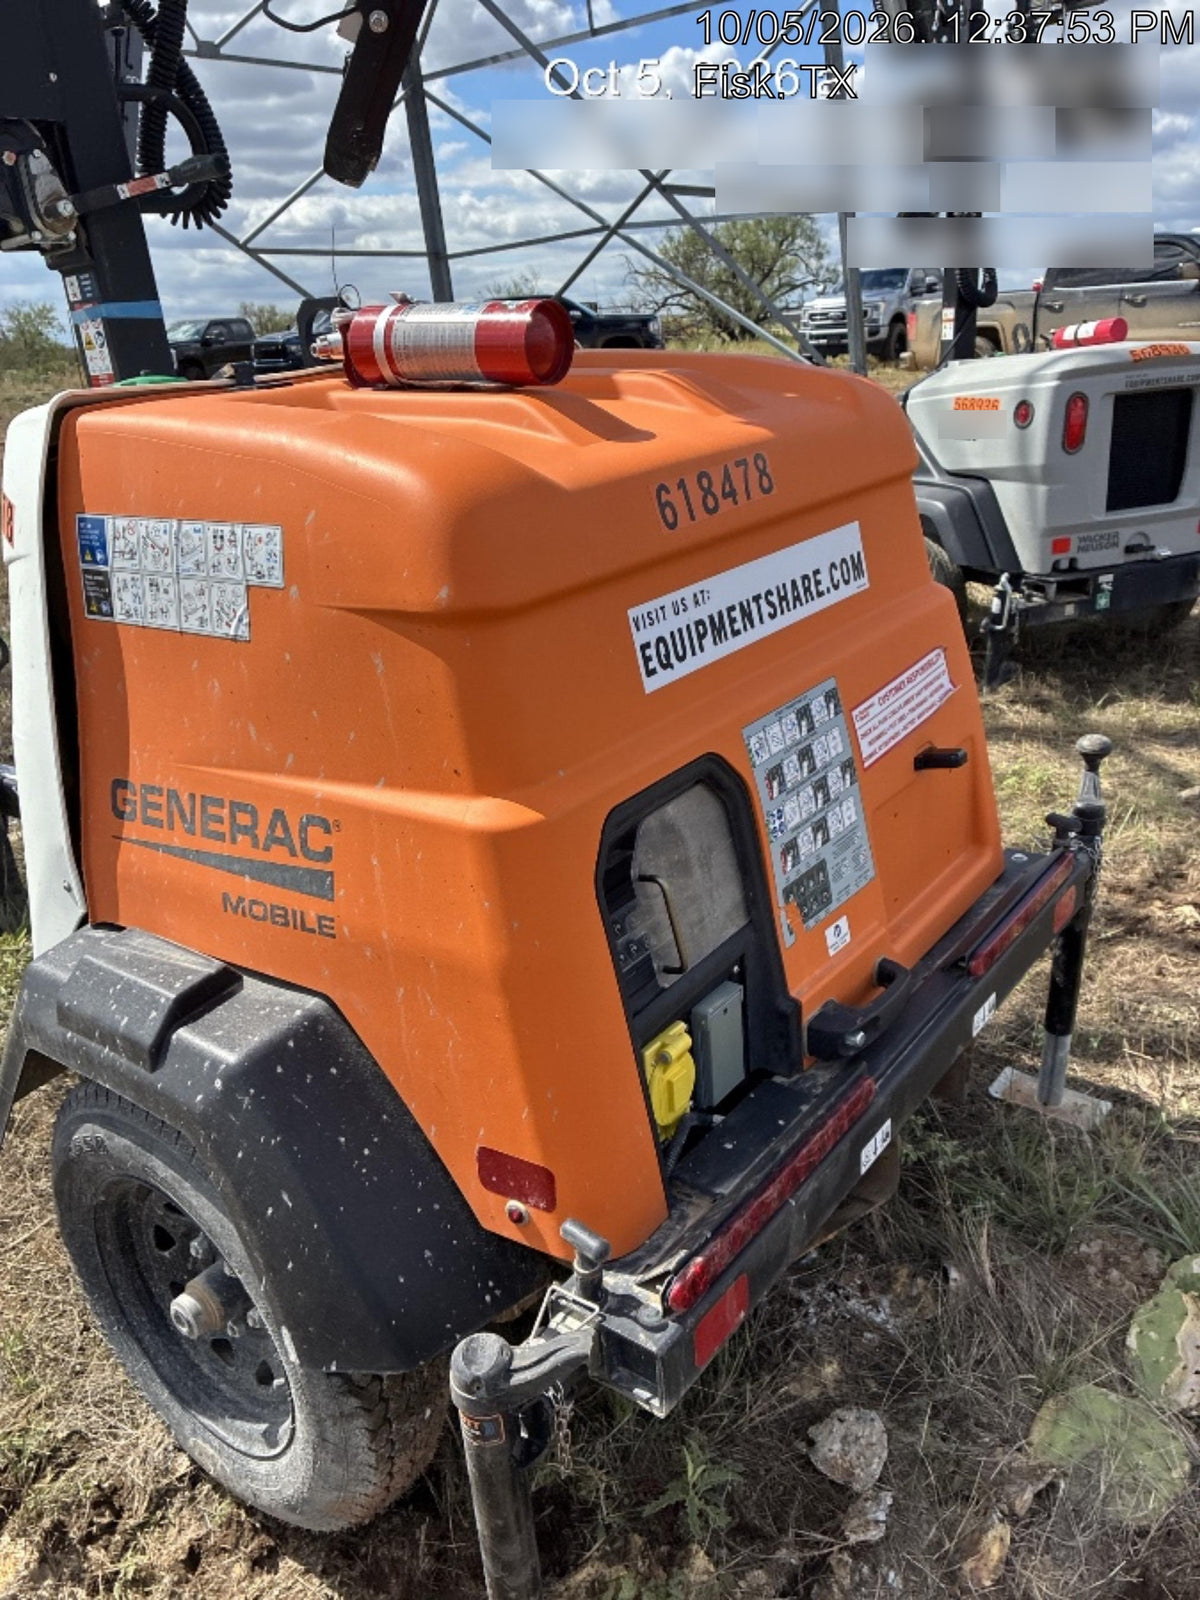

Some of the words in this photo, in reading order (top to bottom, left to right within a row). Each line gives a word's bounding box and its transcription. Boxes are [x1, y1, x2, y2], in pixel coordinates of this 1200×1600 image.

[655, 452, 775, 531] 618478
[632, 605, 667, 632] VISIT
[671, 597, 689, 616] US
[693, 589, 711, 608] AT:
[639, 551, 865, 678] EQUIPMENTSHARE.COM
[222, 892, 337, 939] MOBILE
